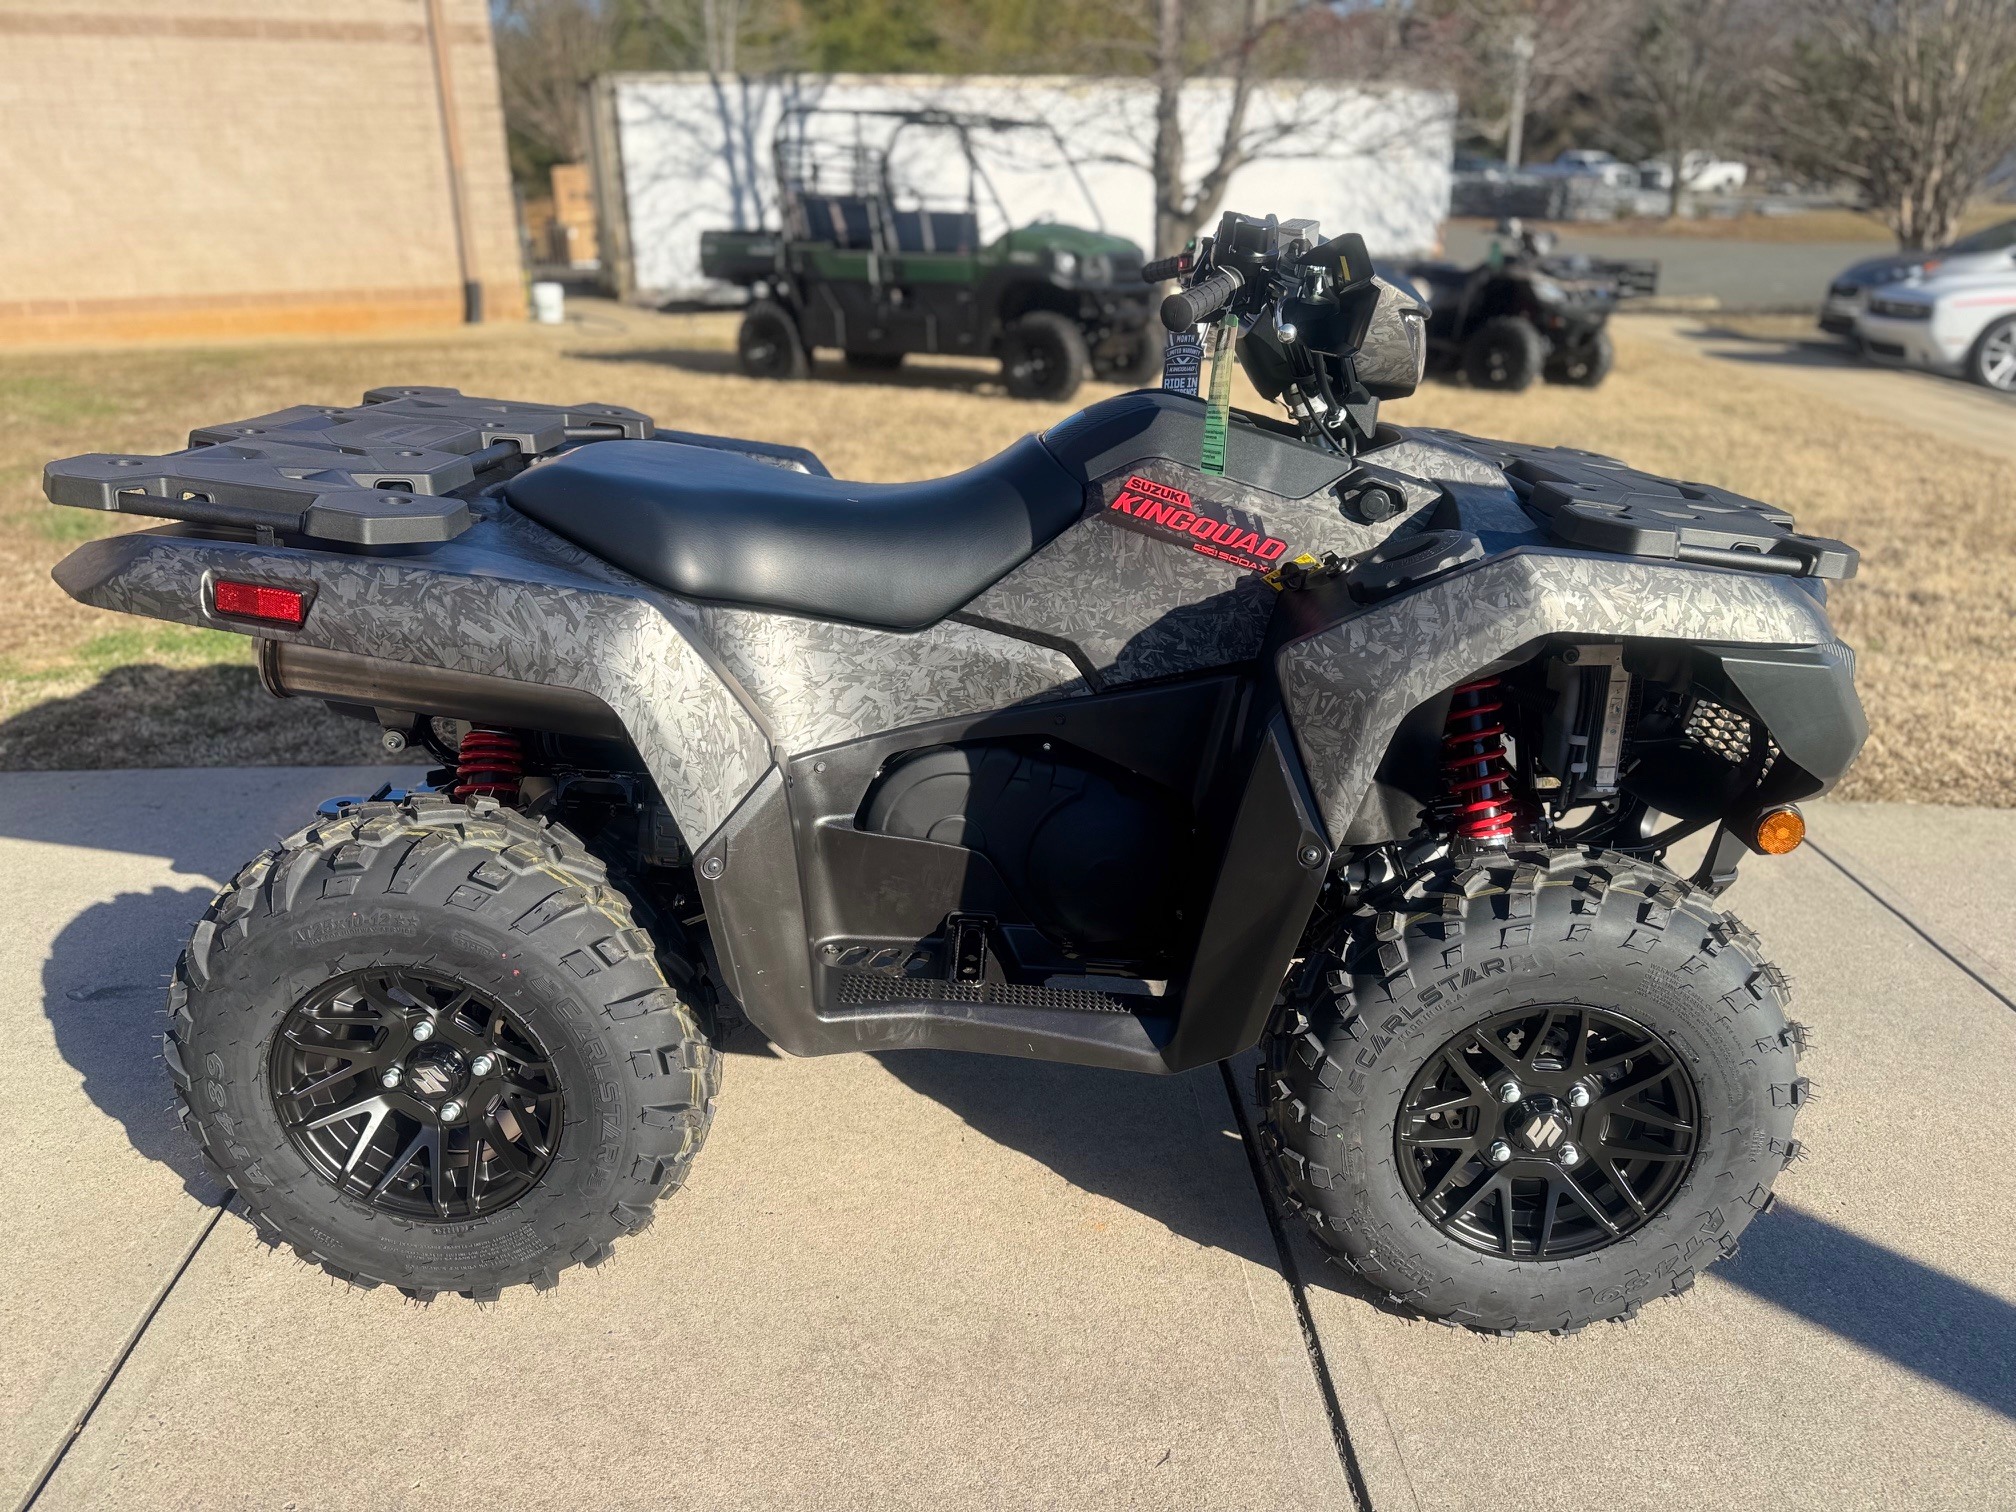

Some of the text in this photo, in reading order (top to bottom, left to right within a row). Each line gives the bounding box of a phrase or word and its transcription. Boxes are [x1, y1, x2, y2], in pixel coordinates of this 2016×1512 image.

[1164, 377, 1198, 389] RIDE IN
[1111, 491, 1288, 560] KINGQUAD
[1131, 478, 1186, 504] SUZUKI
[1356, 957, 1507, 1069] CARLSTAR
[555, 997, 622, 1165] CARLSTAR
